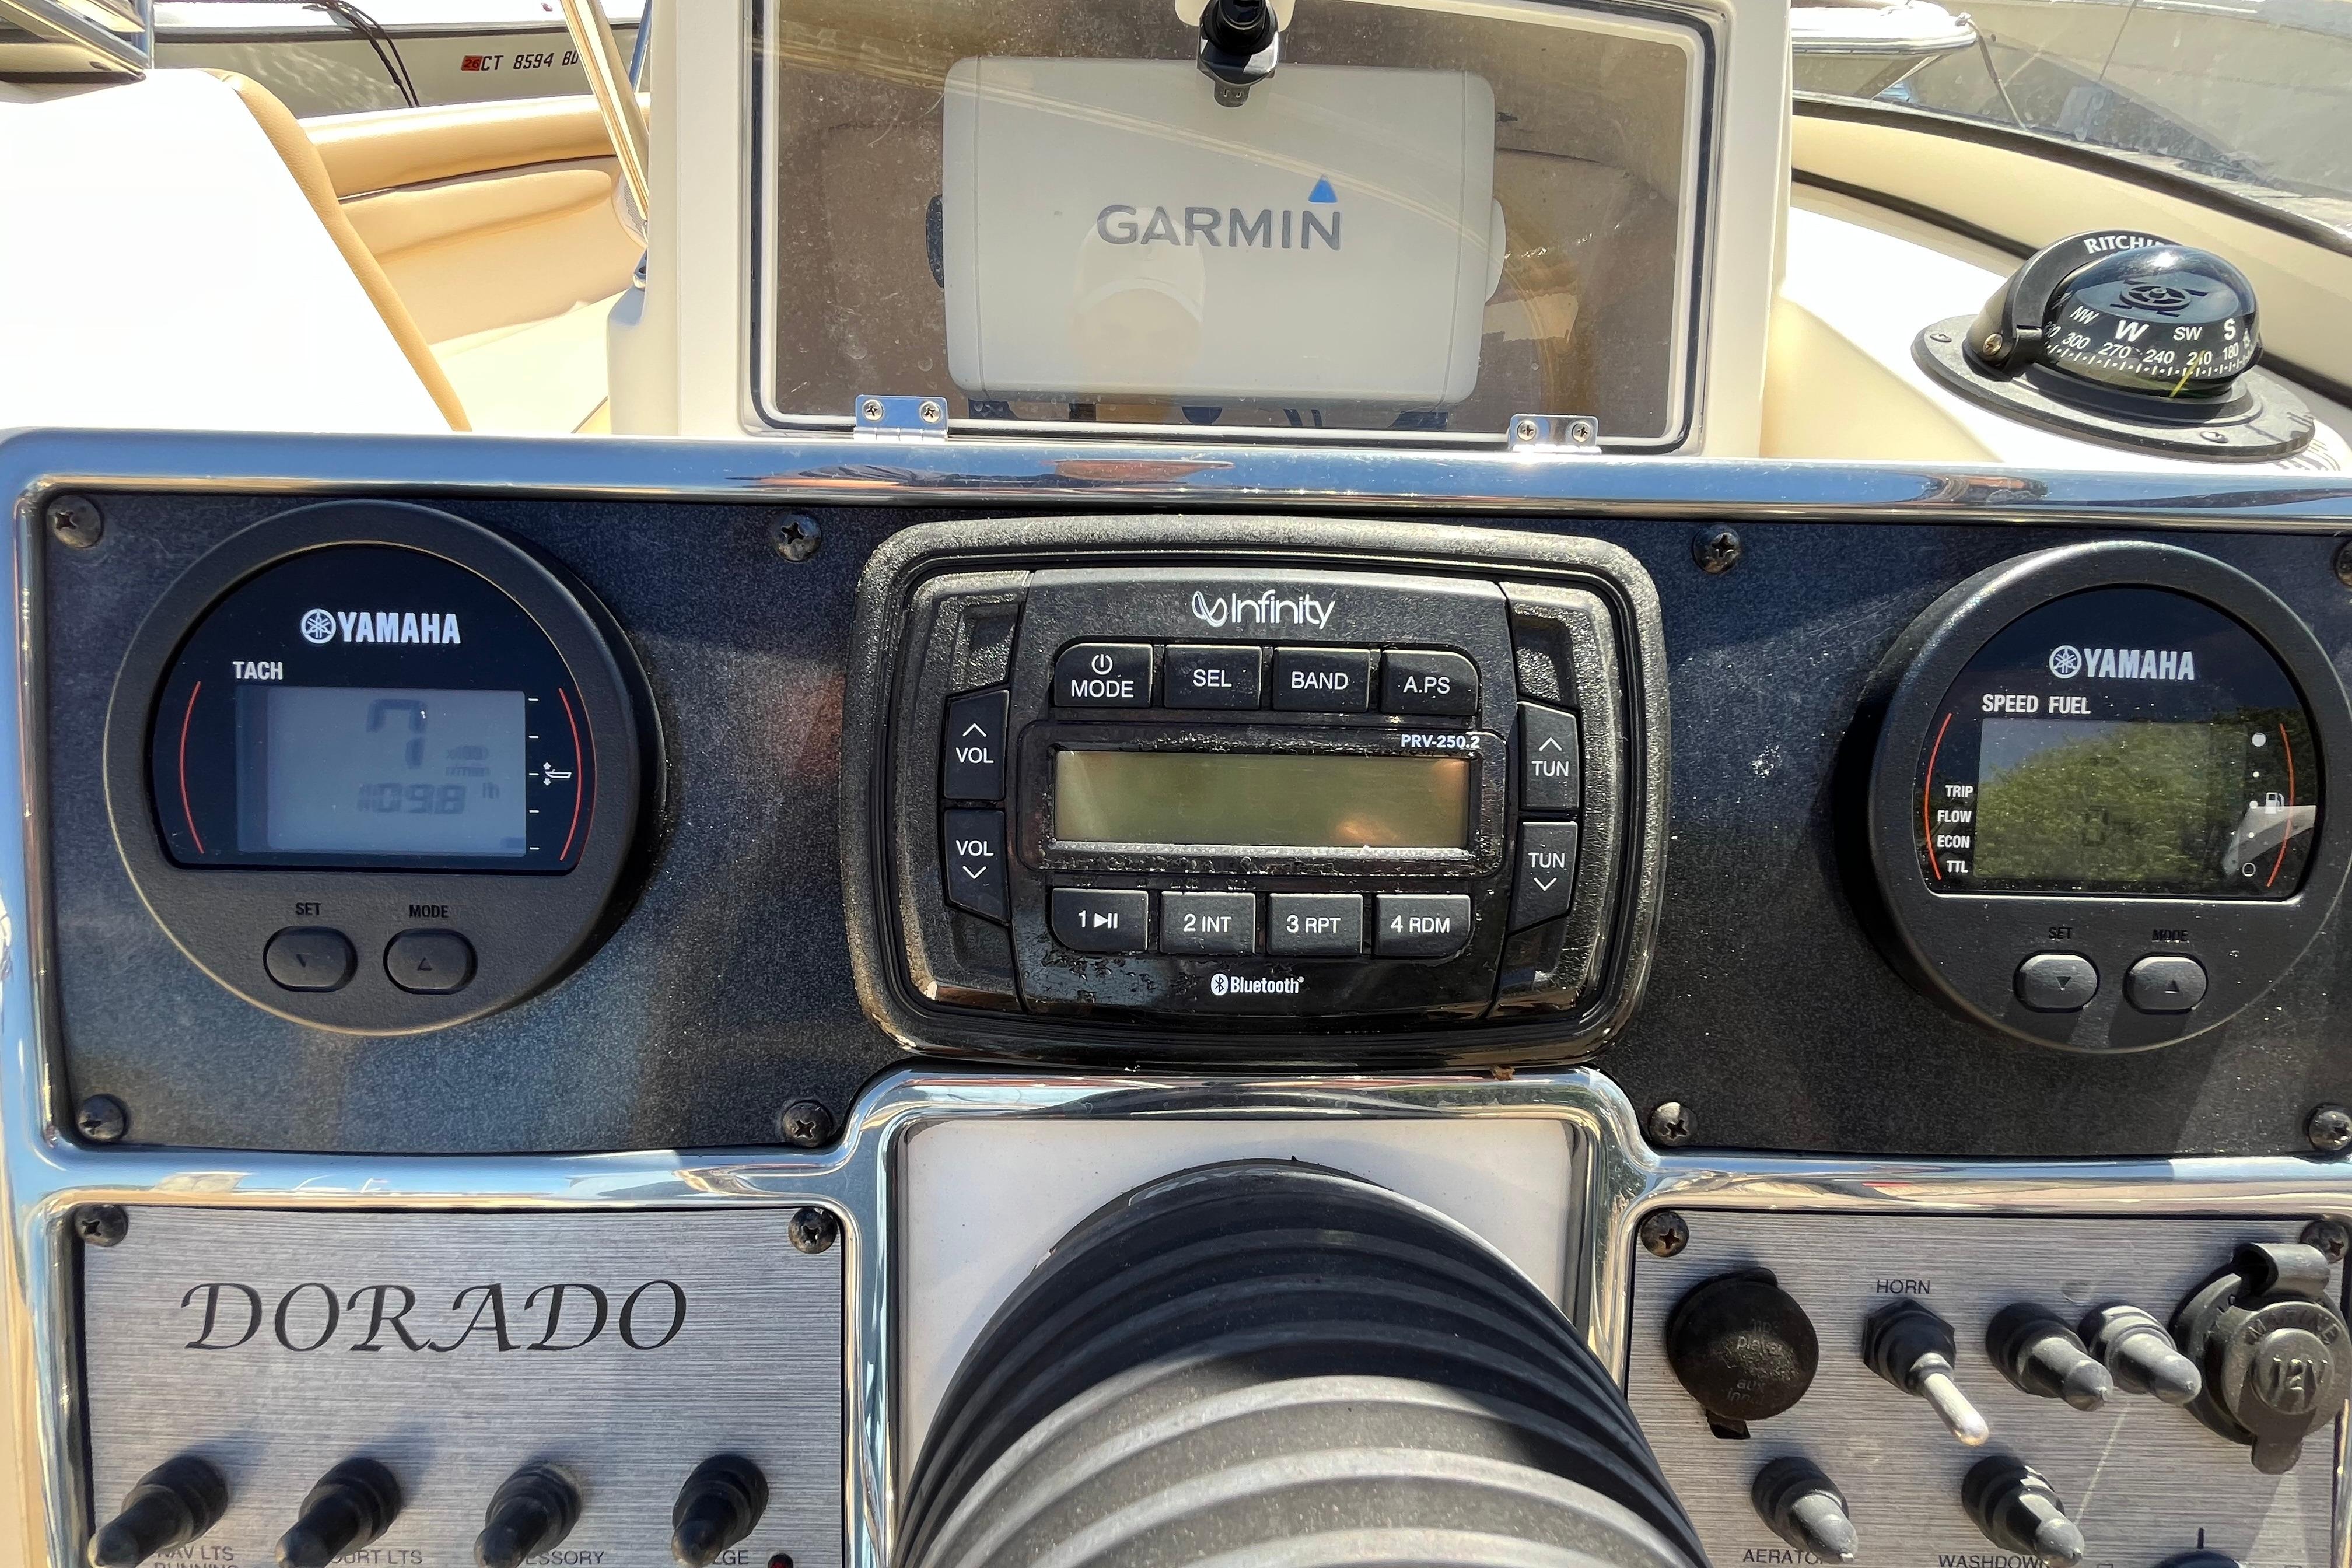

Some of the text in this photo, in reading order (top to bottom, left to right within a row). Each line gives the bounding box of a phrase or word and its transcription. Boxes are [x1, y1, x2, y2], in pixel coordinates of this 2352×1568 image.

[464, 58, 480, 69] 26
[481, 55, 504, 71] CT
[513, 52, 554, 69] 8594
[1097, 204, 1340, 251] GARMIN
[2083, 235, 2165, 254] RITCHI
[2069, 306, 2099, 324] NW
[2115, 320, 2150, 342] W
[2173, 326, 2202, 341] SW
[2224, 318, 2236, 340] S
[2062, 332, 2091, 350] 300
[2098, 342, 2132, 359] 270
[2142, 349, 2175, 365] 240
[2222, 342, 2239, 360] 180
[337, 611, 461, 645] YAMAHA
[233, 661, 284, 681] TACH
[2084, 648, 2194, 680] YAMAHA
[1193, 669, 1233, 687] SEL
[1292, 672, 1349, 690] BAND
[1404, 677, 1451, 694] A.PS
[1071, 680, 1134, 698] MODE
[1982, 694, 2091, 715] SPEED FUEL
[1401, 734, 1480, 749] PRV-250.2
[956, 747, 994, 764] VOL
[1531, 760, 1569, 777] TUN
[1945, 785, 1974, 799] TRIP
[1937, 810, 1972, 824] FLOW
[956, 840, 994, 857] VOL
[1937, 835, 1970, 848] ECON
[1528, 852, 1565, 869] TUN
[1945, 860, 1969, 874] TTL
[295, 902, 322, 916] SET
[409, 904, 449, 918] MODE
[1077, 910, 1087, 928] 1
[1183, 914, 1232, 933] 2 INT
[1286, 915, 1341, 933] 3 RPT
[1390, 915, 1451, 933] 4 RDM
[2048, 926, 2073, 940] SET
[1875, 1279, 1931, 1294] HORN
[180, 1279, 687, 1353] DORADO
[201, 1545, 233, 1561] LTS
[388, 1549, 422, 1564] LTS
[1742, 1548, 1823, 1564] AERATO
